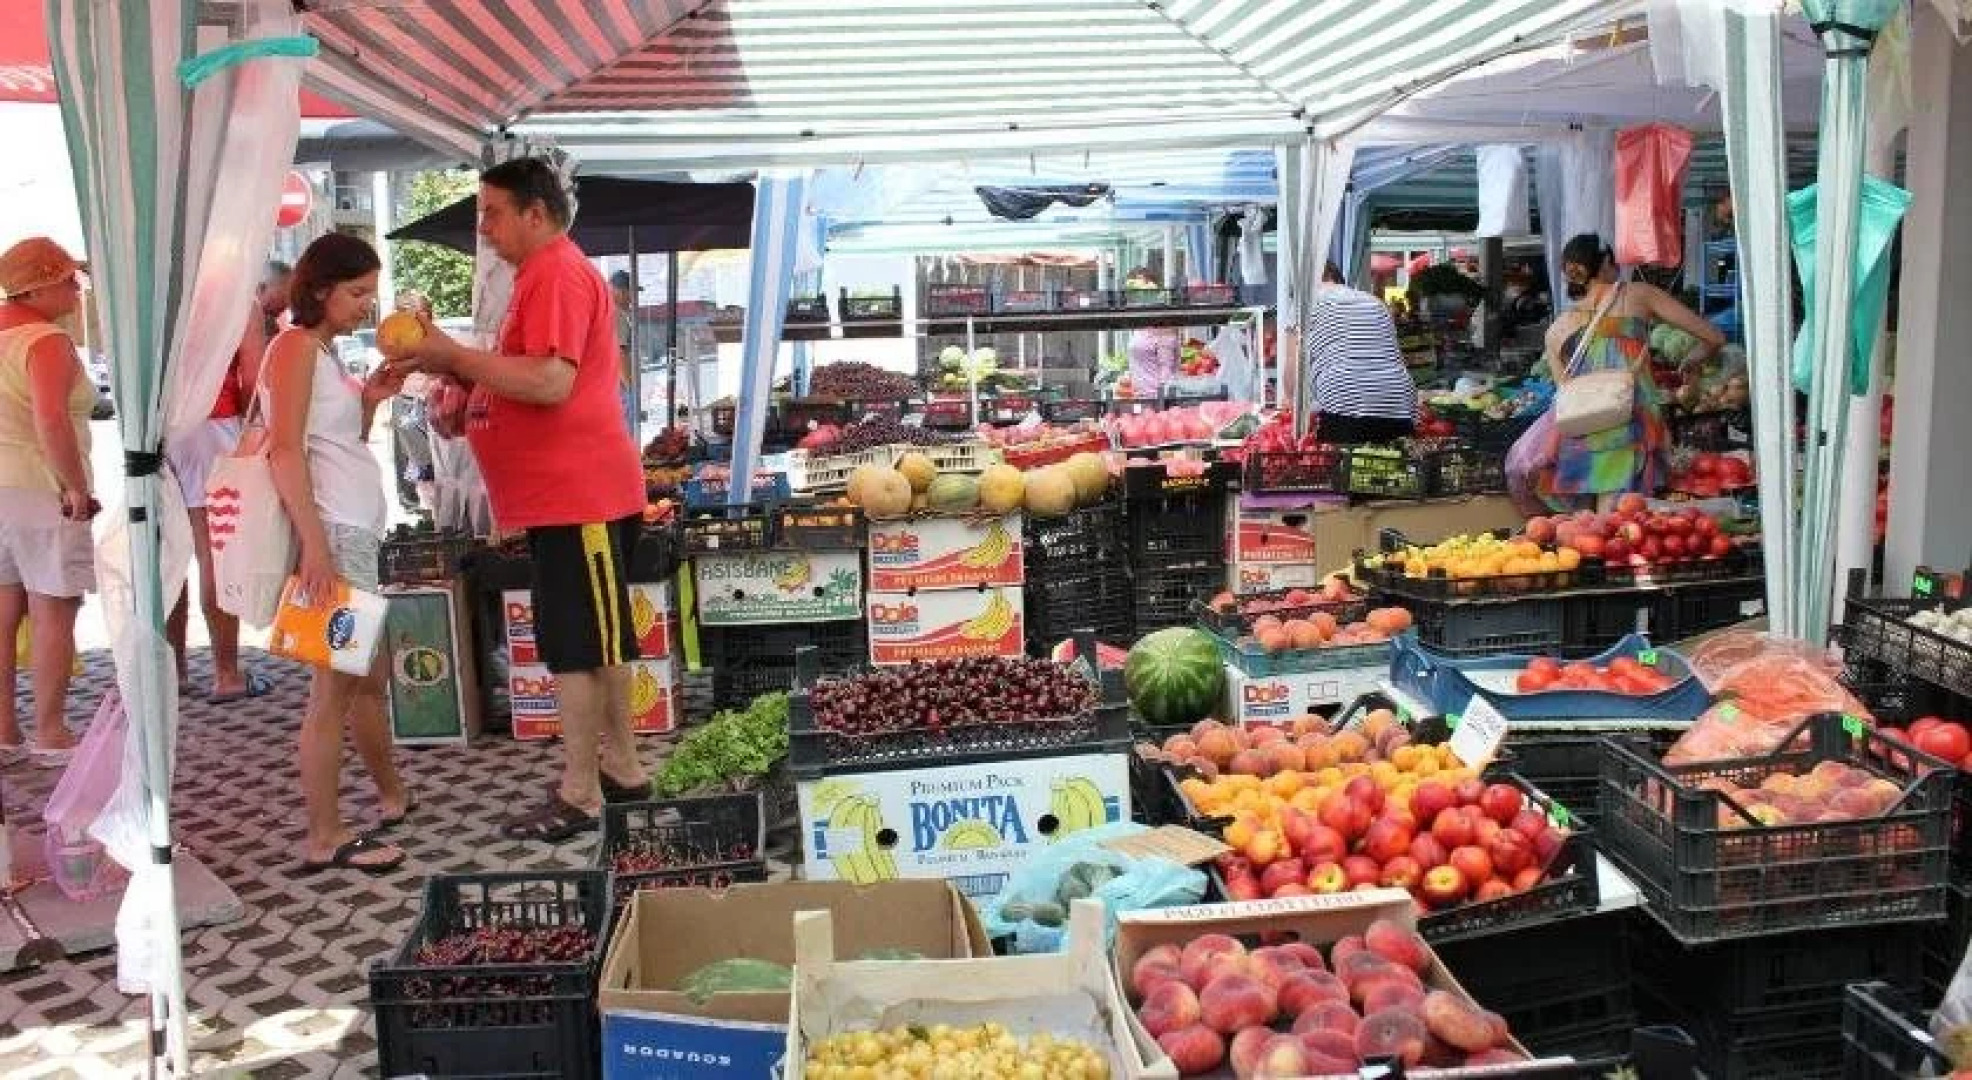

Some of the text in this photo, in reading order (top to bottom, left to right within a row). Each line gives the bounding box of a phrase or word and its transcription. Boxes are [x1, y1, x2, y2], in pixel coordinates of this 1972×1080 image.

[871, 529, 919, 551] Dole
[871, 602, 919, 624] Dole
[1243, 680, 1290, 703] Dole
[910, 774, 1023, 796] PREMIUM PACK
[909, 795, 1029, 852] BONITA
[624, 1044, 731, 1066] ECUADOR
